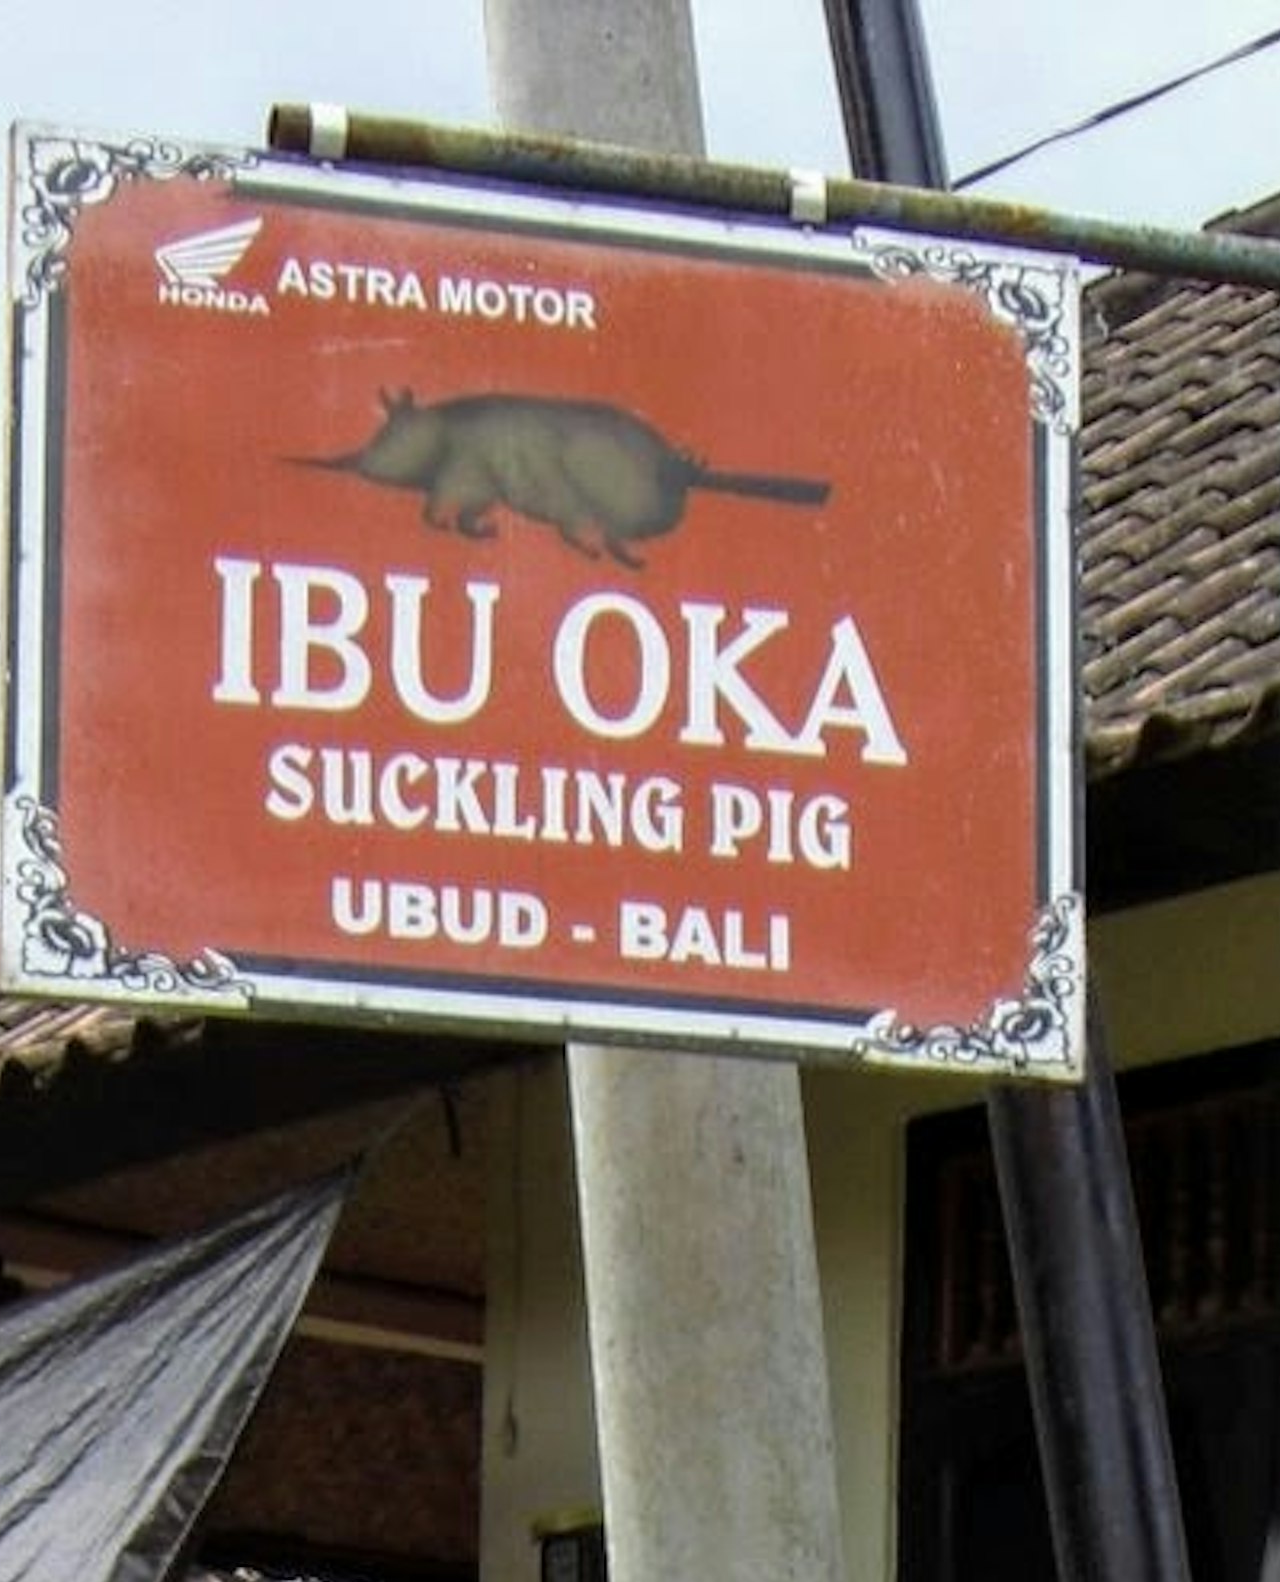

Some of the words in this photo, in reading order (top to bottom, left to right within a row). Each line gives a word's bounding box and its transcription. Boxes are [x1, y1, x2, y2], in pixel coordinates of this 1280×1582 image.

[158, 283, 271, 316] HONDA
[276, 257, 427, 311] ASTRA
[437, 274, 597, 330] MOTOR
[212, 556, 501, 725] IBU
[552, 590, 909, 766] OKA
[264, 743, 685, 853] SUCKLING
[709, 782, 853, 871] PIG
[331, 878, 548, 948] UBUD
[571, 921, 597, 942] -
[619, 901, 790, 971] BALI
